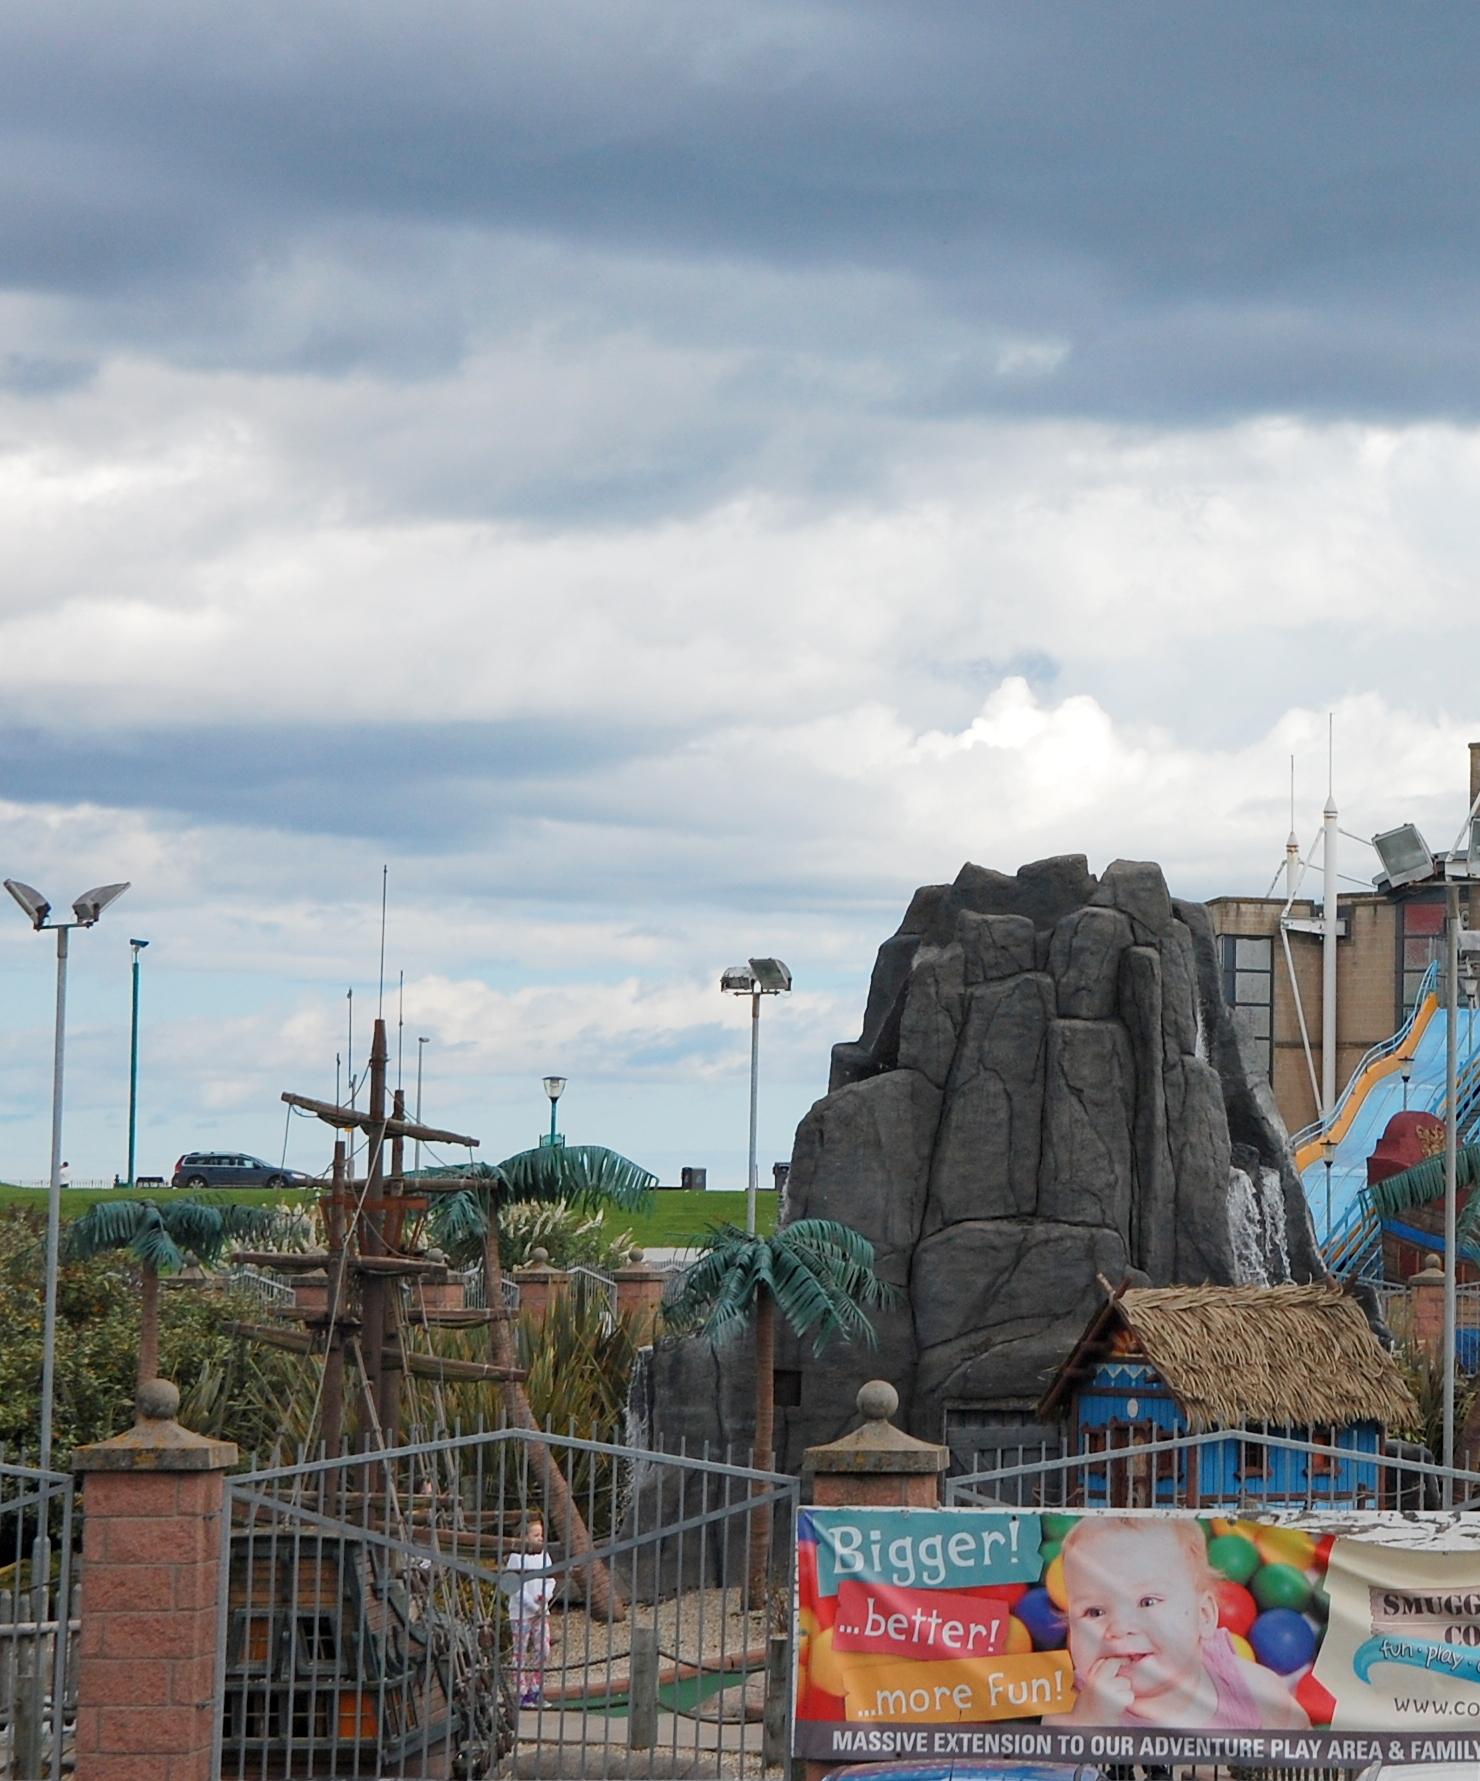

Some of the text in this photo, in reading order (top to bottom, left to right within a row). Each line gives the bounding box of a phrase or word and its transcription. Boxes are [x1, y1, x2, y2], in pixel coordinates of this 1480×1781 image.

[828, 1519, 1020, 1587] Bigger!
[1380, 1639, 1414, 1659] fun
[1425, 1645, 1464, 1671] play
[832, 1730, 928, 1752] MASSIVE
[934, 1732, 1051, 1754] EXTENSION
[1058, 1734, 1084, 1755] TO
[1091, 1735, 1134, 1756] OUR
[1139, 1736, 1264, 1758] ADVENTURE
[1270, 1738, 1322, 1759] PLAY
[1327, 1740, 1383, 1760] AREA
[1389, 1740, 1404, 1760] &
